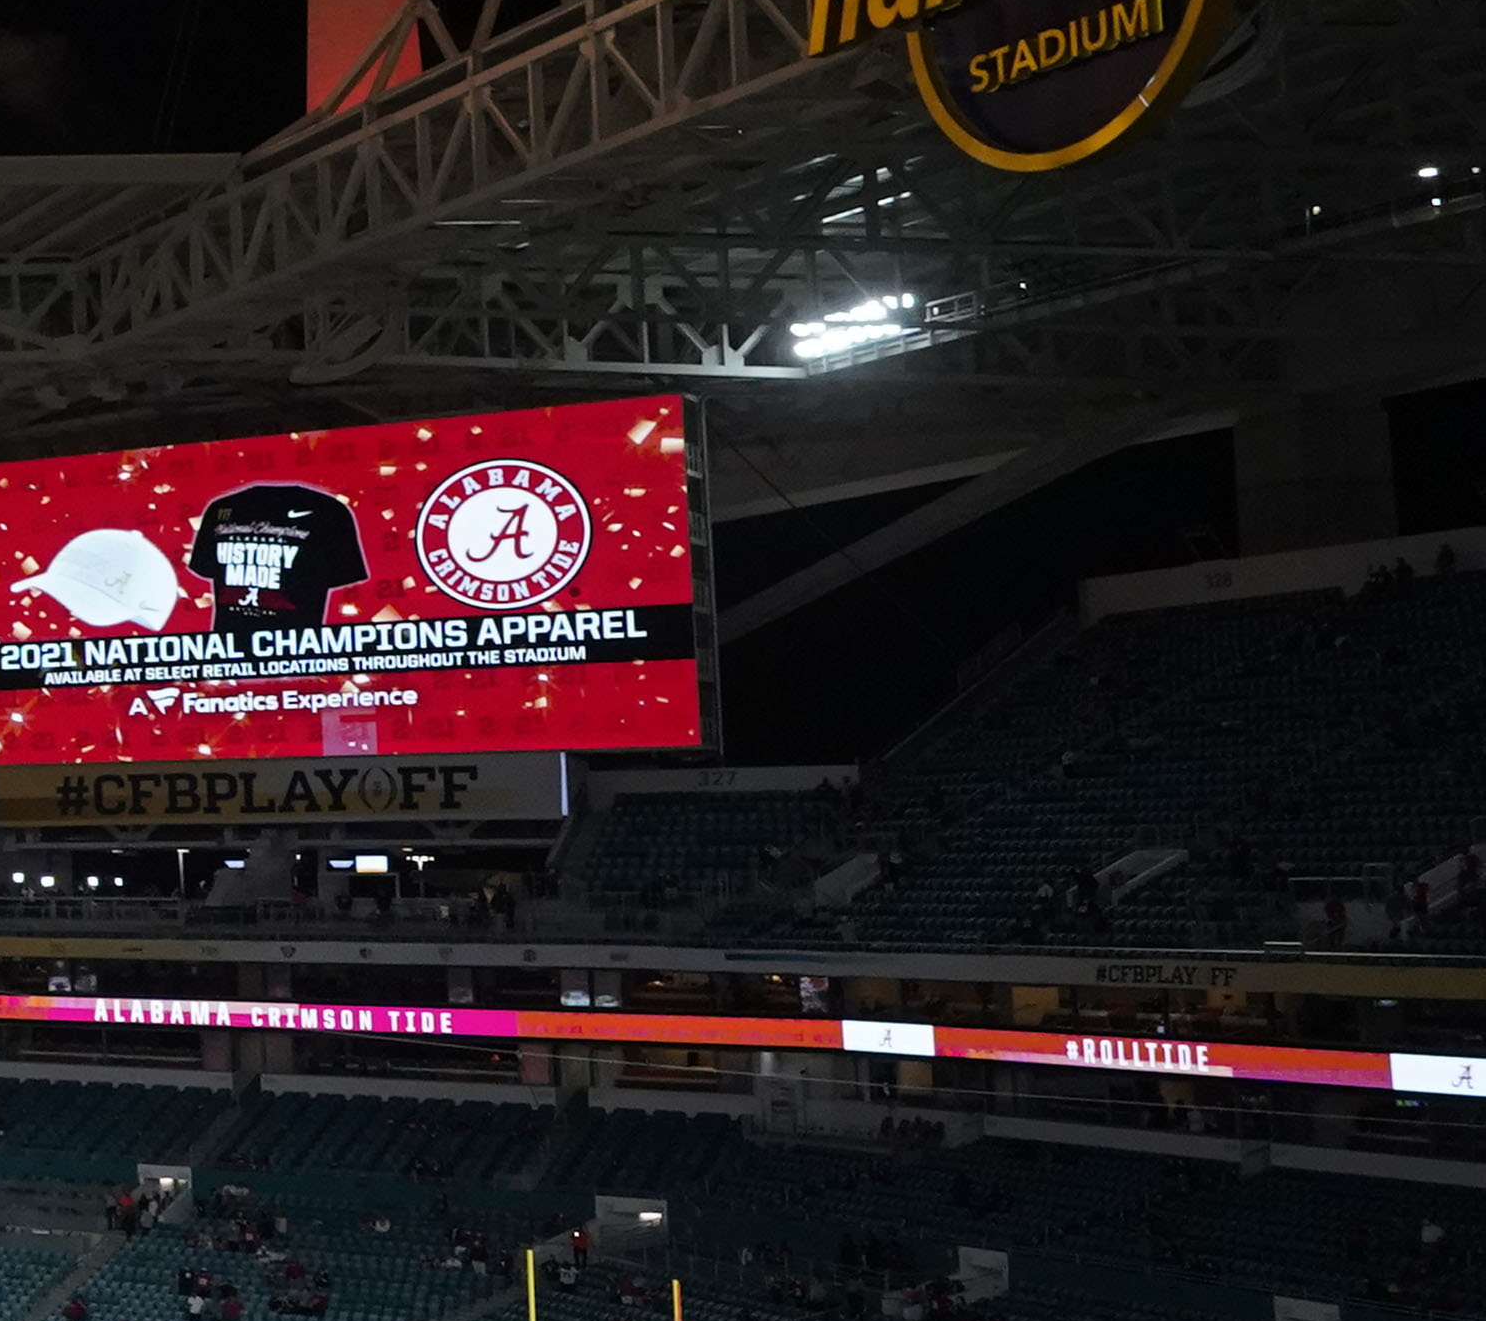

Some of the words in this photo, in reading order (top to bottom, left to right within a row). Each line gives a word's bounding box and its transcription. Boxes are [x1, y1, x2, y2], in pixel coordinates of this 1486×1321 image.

[428, 467, 577, 530] ALABAMA
[465, 503, 535, 564] A
[216, 541, 300, 569] HISTORY
[428, 546, 530, 603] CRIMSON
[533, 539, 580, 590] TIDE
[225, 565, 282, 590] MADE
[0, 642, 77, 670] 2021
[84, 632, 245, 667] NATIONAL
[251, 619, 468, 657] CHAMPIONS
[476, 609, 648, 647] APPAREL
[44, 669, 122, 685] AVAILABLE
[123, 668, 143, 681] AT
[145, 666, 200, 680] SELECT
[202, 662, 256, 678] RETAIL
[259, 657, 349, 675] LOCATIONS
[353, 652, 463, 671] THROUGHOUT
[466, 649, 501, 665] THE
[504, 645, 586, 664] STADIUM
[128, 697, 148, 716] A
[182, 690, 279, 714] Fanatics
[282, 686, 418, 713] Experience
[1096, 965, 1237, 987] #CFBPLAYFF
[93, 998, 231, 1026] ALABAMA
[250, 1005, 375, 1032] CRIMSON
[388, 1010, 455, 1035] TIDE
[1065, 1037, 1211, 1074] #ROLLTIDE
